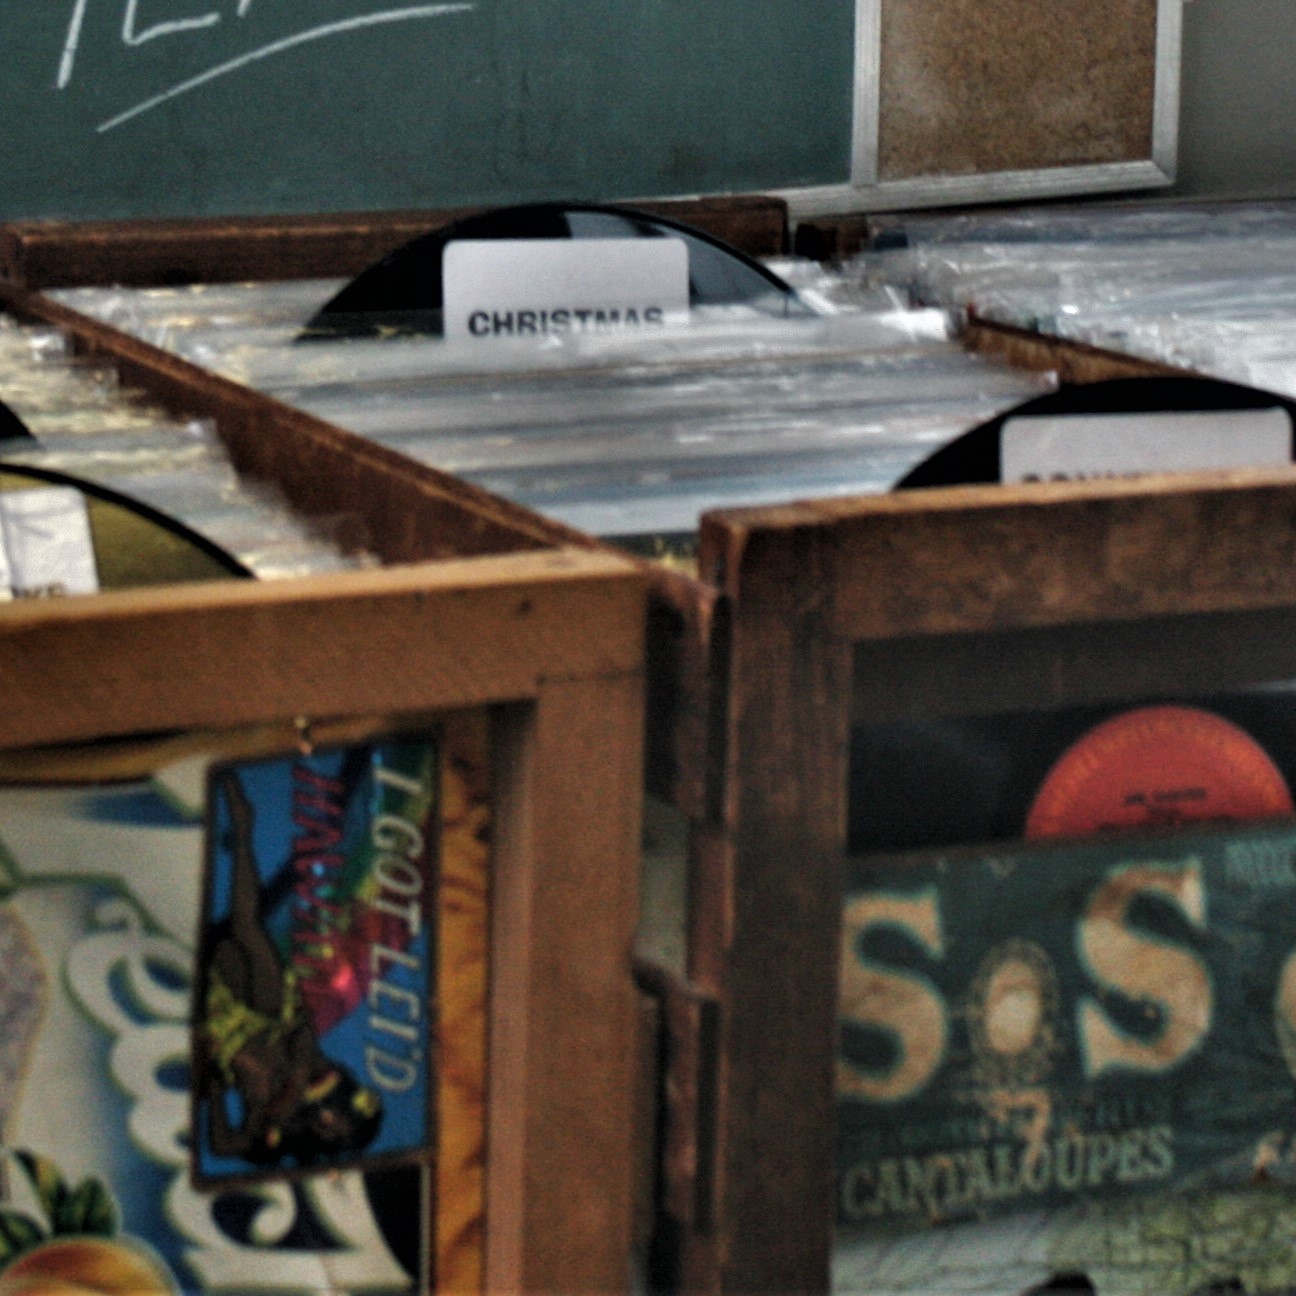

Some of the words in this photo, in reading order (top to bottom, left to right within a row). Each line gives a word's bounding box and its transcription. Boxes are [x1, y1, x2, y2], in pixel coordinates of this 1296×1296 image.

[467, 306, 665, 338] CHRISTMAS
[371, 815, 424, 936] GOT
[842, 1125, 1175, 1215] CANTALOUPES
